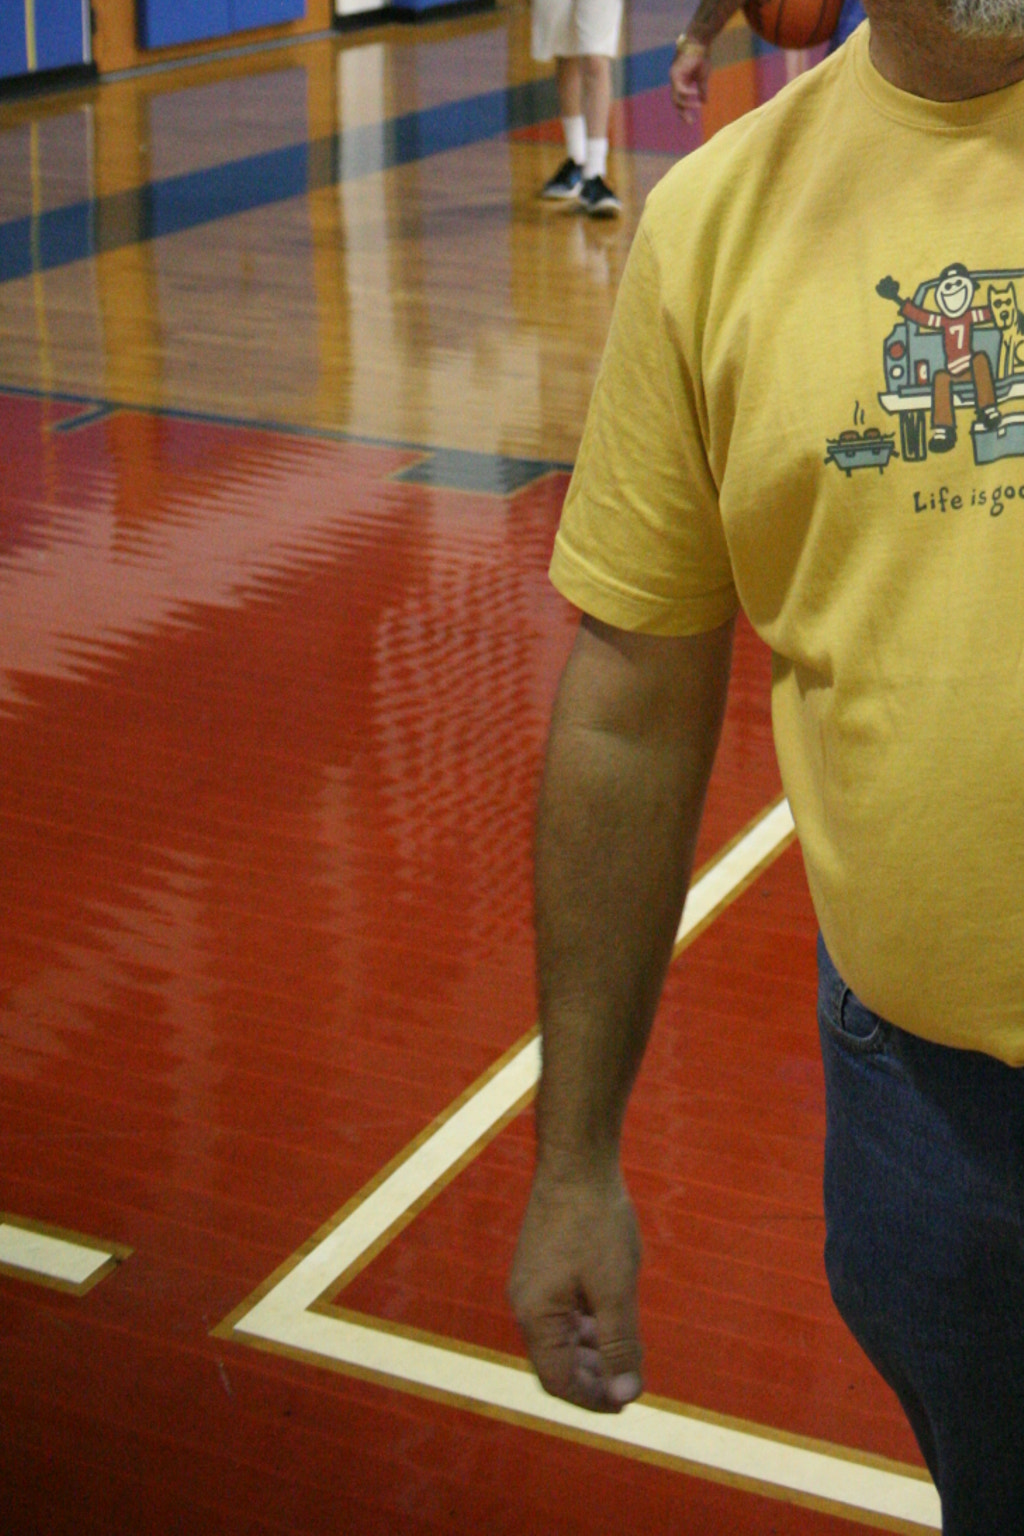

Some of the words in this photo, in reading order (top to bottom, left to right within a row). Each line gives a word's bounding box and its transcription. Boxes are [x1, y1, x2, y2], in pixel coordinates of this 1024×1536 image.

[949, 324, 964, 349] 7
[913, 486, 963, 513] Life
[971, 489, 987, 505] is
